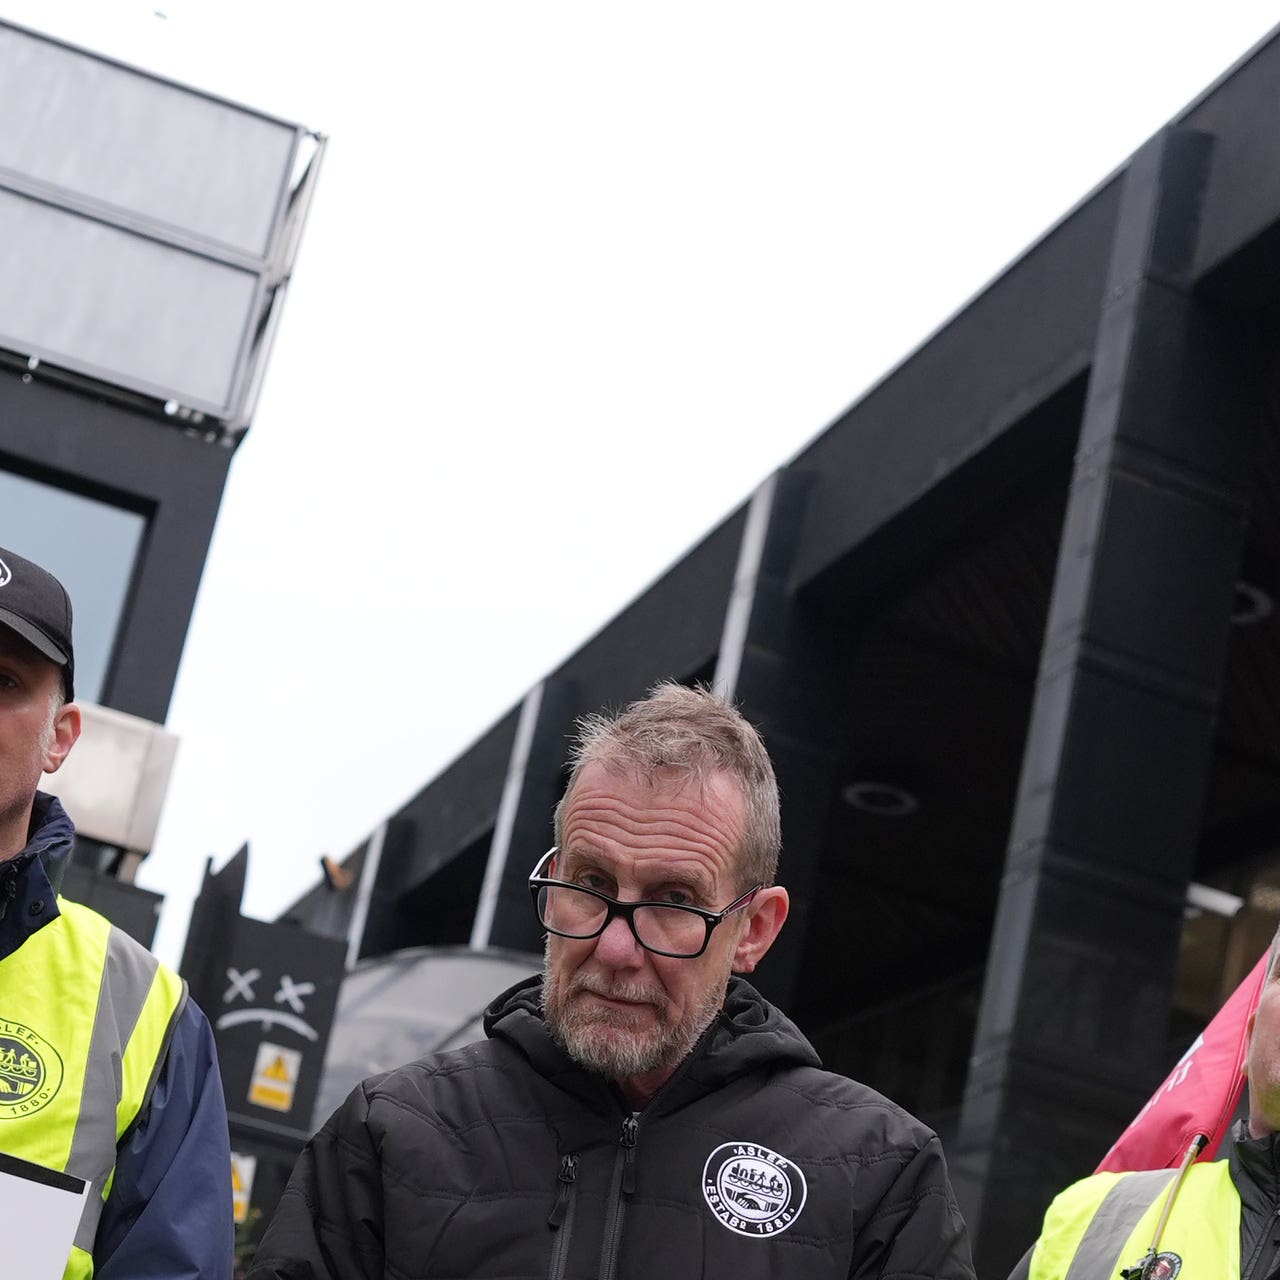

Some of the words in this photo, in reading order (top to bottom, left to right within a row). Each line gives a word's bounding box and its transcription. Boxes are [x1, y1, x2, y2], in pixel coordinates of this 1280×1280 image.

[10, 1093, 49, 1115] 1880
[736, 1145, 786, 1167] ASLEF
[757, 1212, 792, 1234] 1880
